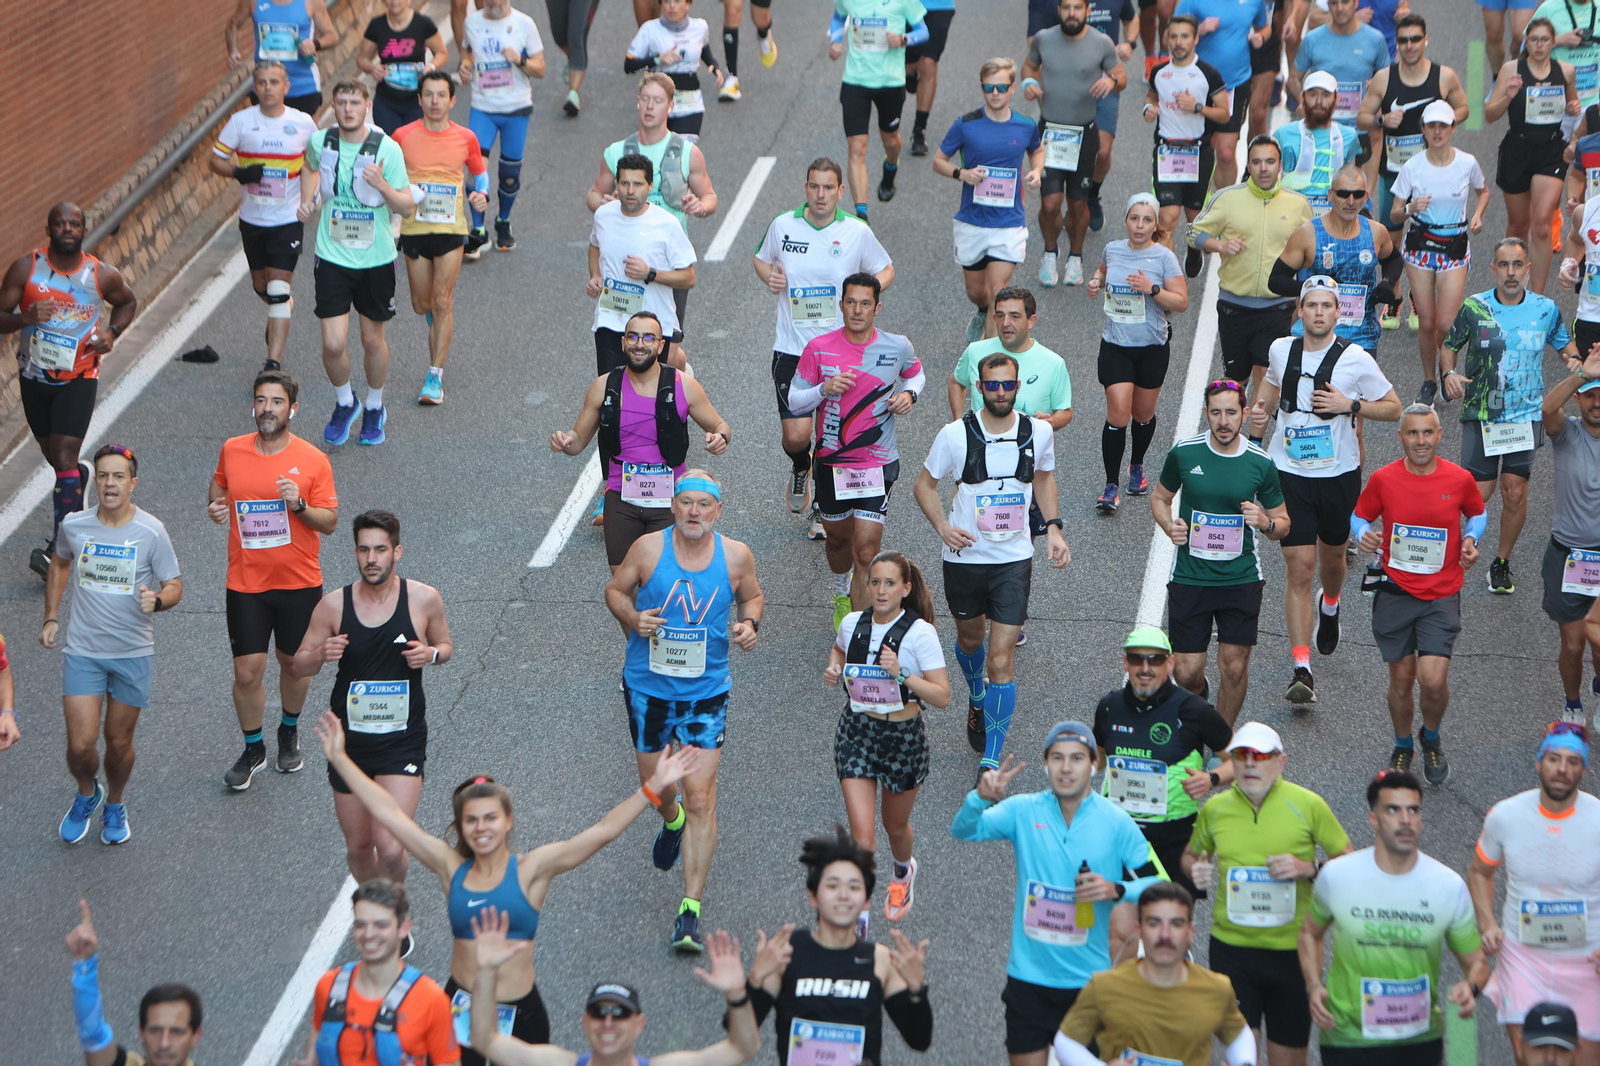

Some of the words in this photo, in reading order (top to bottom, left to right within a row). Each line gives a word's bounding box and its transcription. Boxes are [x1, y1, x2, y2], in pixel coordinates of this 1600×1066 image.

[992, 170, 1013, 178] ZURICH
[346, 212, 370, 220] ZURICH
[615, 282, 640, 293] ZURICH
[806, 288, 831, 296] ZURICH
[1115, 286, 1138, 294] ZURICH
[1338, 287, 1362, 296] ZURICH
[807, 312, 823, 320] DAVID
[46, 334, 72, 346] ZURICH
[1298, 428, 1326, 438] ZURICH
[1499, 428, 1515, 436] 8937
[1300, 444, 1316, 452] 5604
[1300, 452, 1320, 460] JAPPIE
[640, 464, 667, 473] ZURICH
[994, 496, 1021, 504] ZURICH
[252, 502, 280, 512] ZURICH
[994, 512, 1010, 521] 7608
[252, 520, 270, 528] 7612
[1210, 518, 1238, 526] ZURICH
[242, 530, 258, 538] MARIO
[258, 528, 287, 538] HORRILLO
[1208, 532, 1226, 541] 8543
[1411, 529, 1440, 539] ZURICH
[1207, 542, 1224, 550] DAVID
[1407, 544, 1428, 554] 10568
[99, 548, 130, 558] ZURICH
[1408, 554, 1424, 562] JUAN
[96, 563, 118, 573] 10560
[1584, 568, 1600, 576] 7742
[109, 574, 128, 584] GZLEZ
[668, 632, 699, 640] ZURICH
[666, 647, 688, 656] 10277
[666, 658, 686, 666] ACHIM
[862, 668, 890, 678] ZURICH
[368, 684, 402, 694] ZURICH
[862, 685, 880, 694] 8373
[362, 713, 394, 721] MEDRANO
[1115, 746, 1152, 758] DANIELE
[1378, 908, 1435, 924] RUNNING
[1364, 922, 1422, 941] sano
[795, 978, 871, 1000] RUSH
